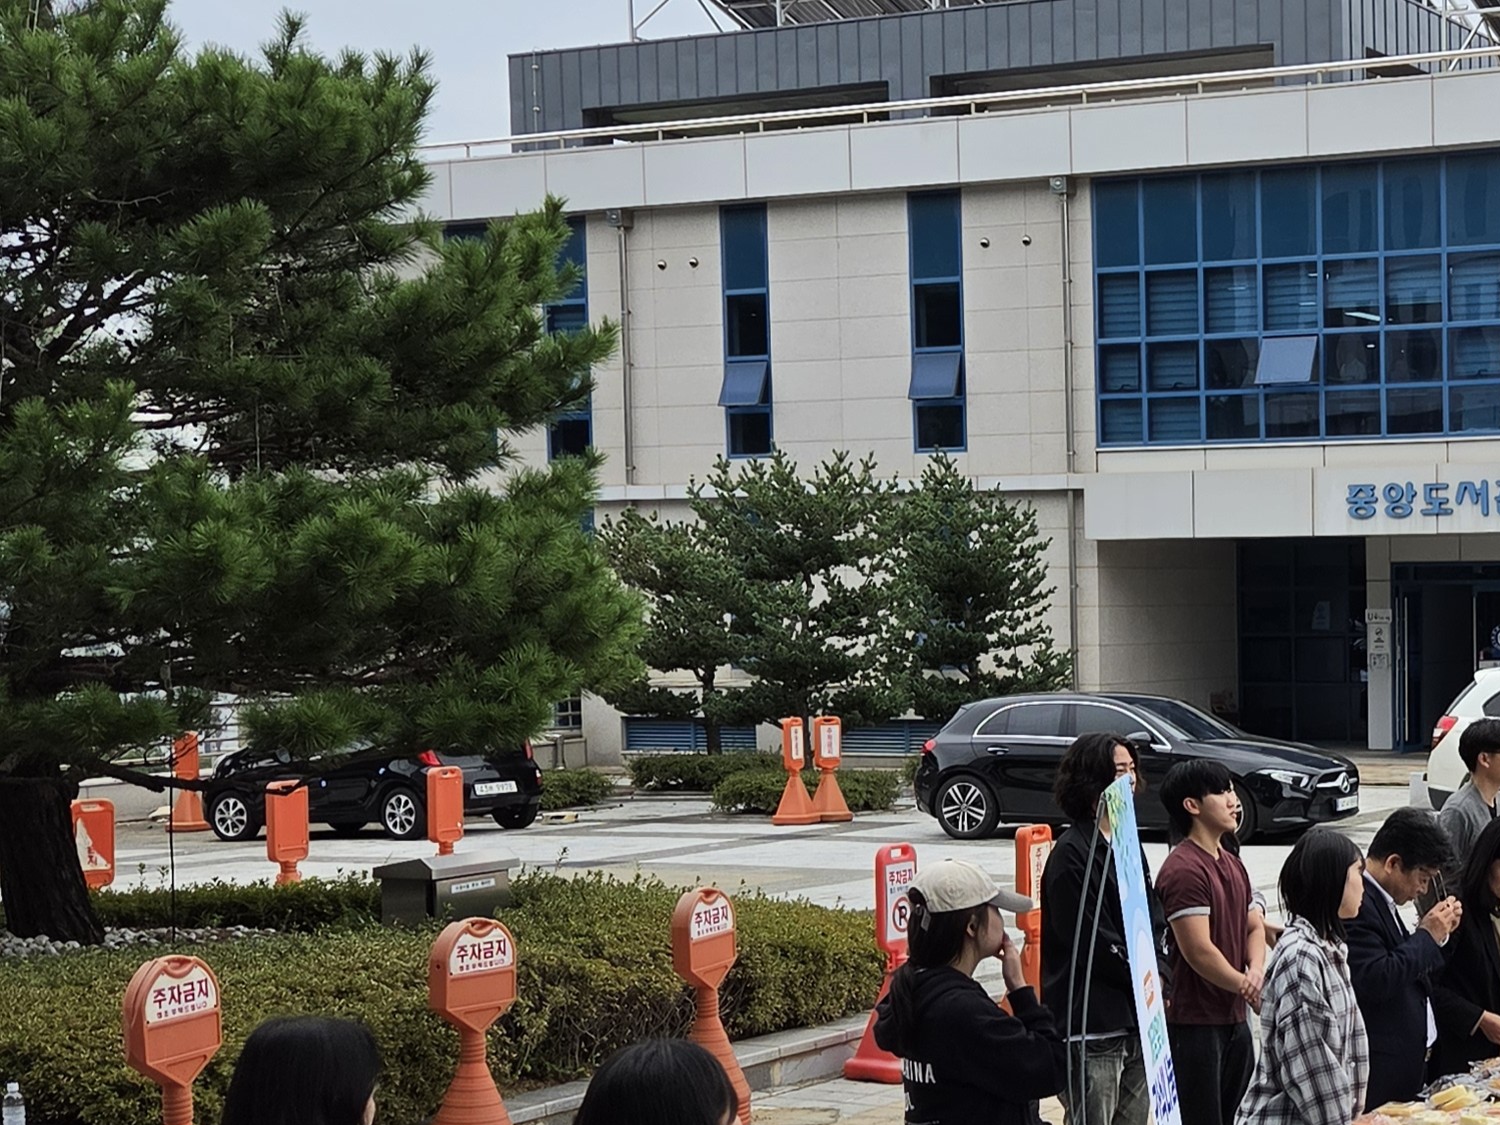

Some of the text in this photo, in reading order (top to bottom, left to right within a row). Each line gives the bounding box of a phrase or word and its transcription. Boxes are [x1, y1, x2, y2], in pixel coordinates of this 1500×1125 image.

[889, 867, 914, 886] 주차금지
[694, 904, 728, 928] 주차금지
[456, 938, 507, 963] 주차금지
[152, 977, 209, 1009] 주차금지
